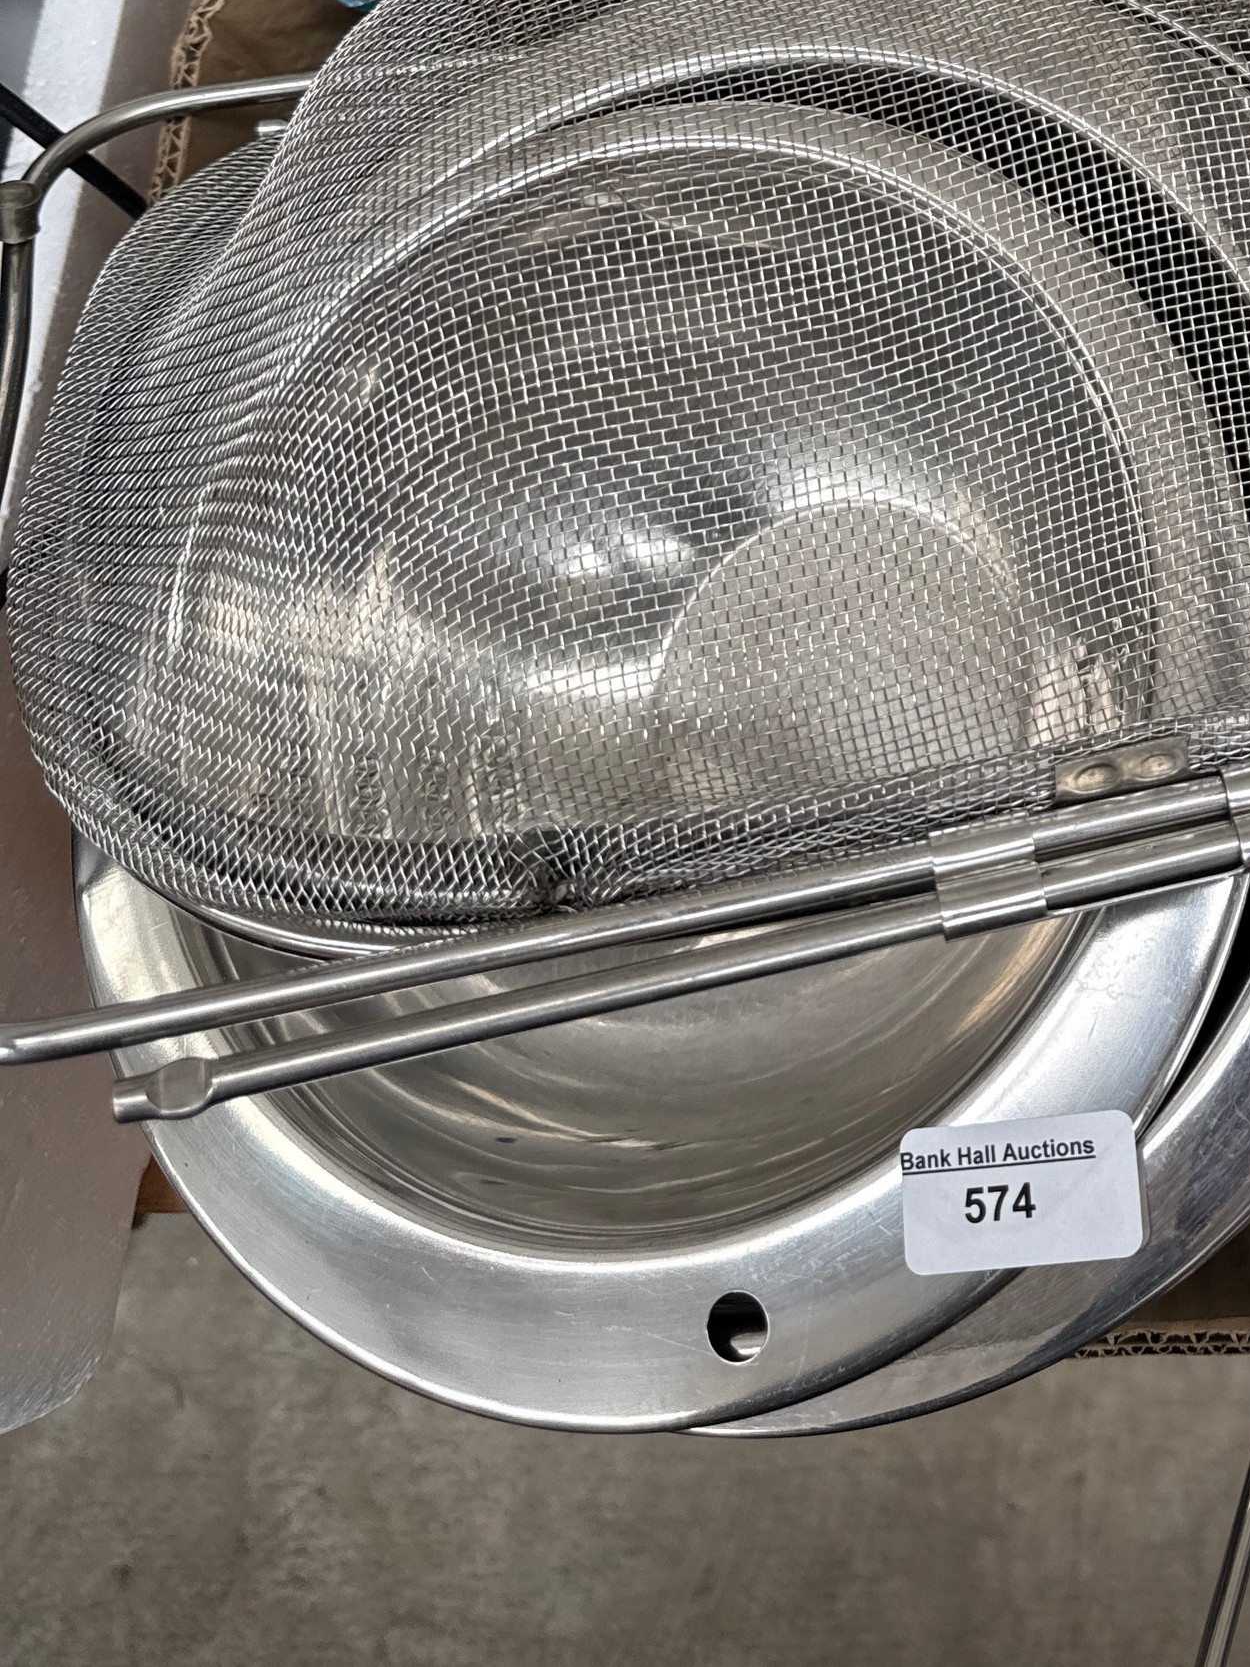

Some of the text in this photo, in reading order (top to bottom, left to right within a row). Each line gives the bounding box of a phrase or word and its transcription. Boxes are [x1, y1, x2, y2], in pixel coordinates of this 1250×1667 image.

[900, 1138, 1095, 1171] Bank Hall Auctions
[964, 1181, 1037, 1224] 574
